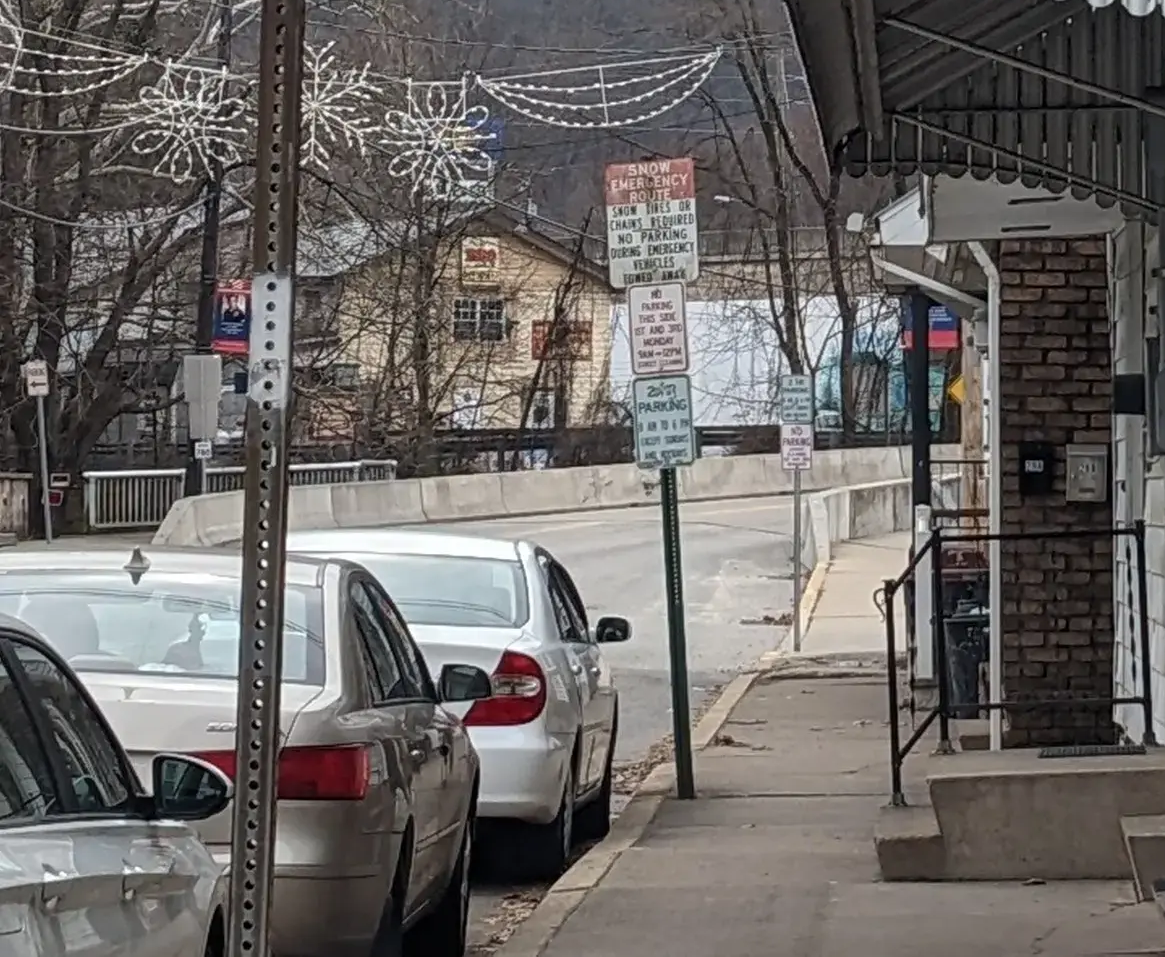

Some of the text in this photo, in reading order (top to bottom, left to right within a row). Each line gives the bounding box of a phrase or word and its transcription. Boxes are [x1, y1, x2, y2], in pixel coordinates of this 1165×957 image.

[628, 162, 671, 176] SNOW
[611, 174, 688, 191] EMERGENCY
[629, 189, 672, 204] ROUTE
[612, 200, 691, 217] SNOW TIRES OR
[609, 213, 694, 231] CHAINS REQUIRED
[617, 229, 688, 244] NO PARKING
[611, 242, 694, 259] DURING EMERGENCY
[633, 256, 675, 270] VEHICLES
[623, 269, 687, 283] TOWED AWAY
[650, 289, 662, 299] NO
[641, 301, 673, 311] PARKING
[639, 312, 676, 323] THIS SIDE
[634, 324, 682, 335] 1ST AND 3RD
[643, 337, 674, 346] MONDAY
[638, 398, 687, 414] PARKING
[790, 426, 804, 436] NO
[782, 438, 811, 446] PARKING
